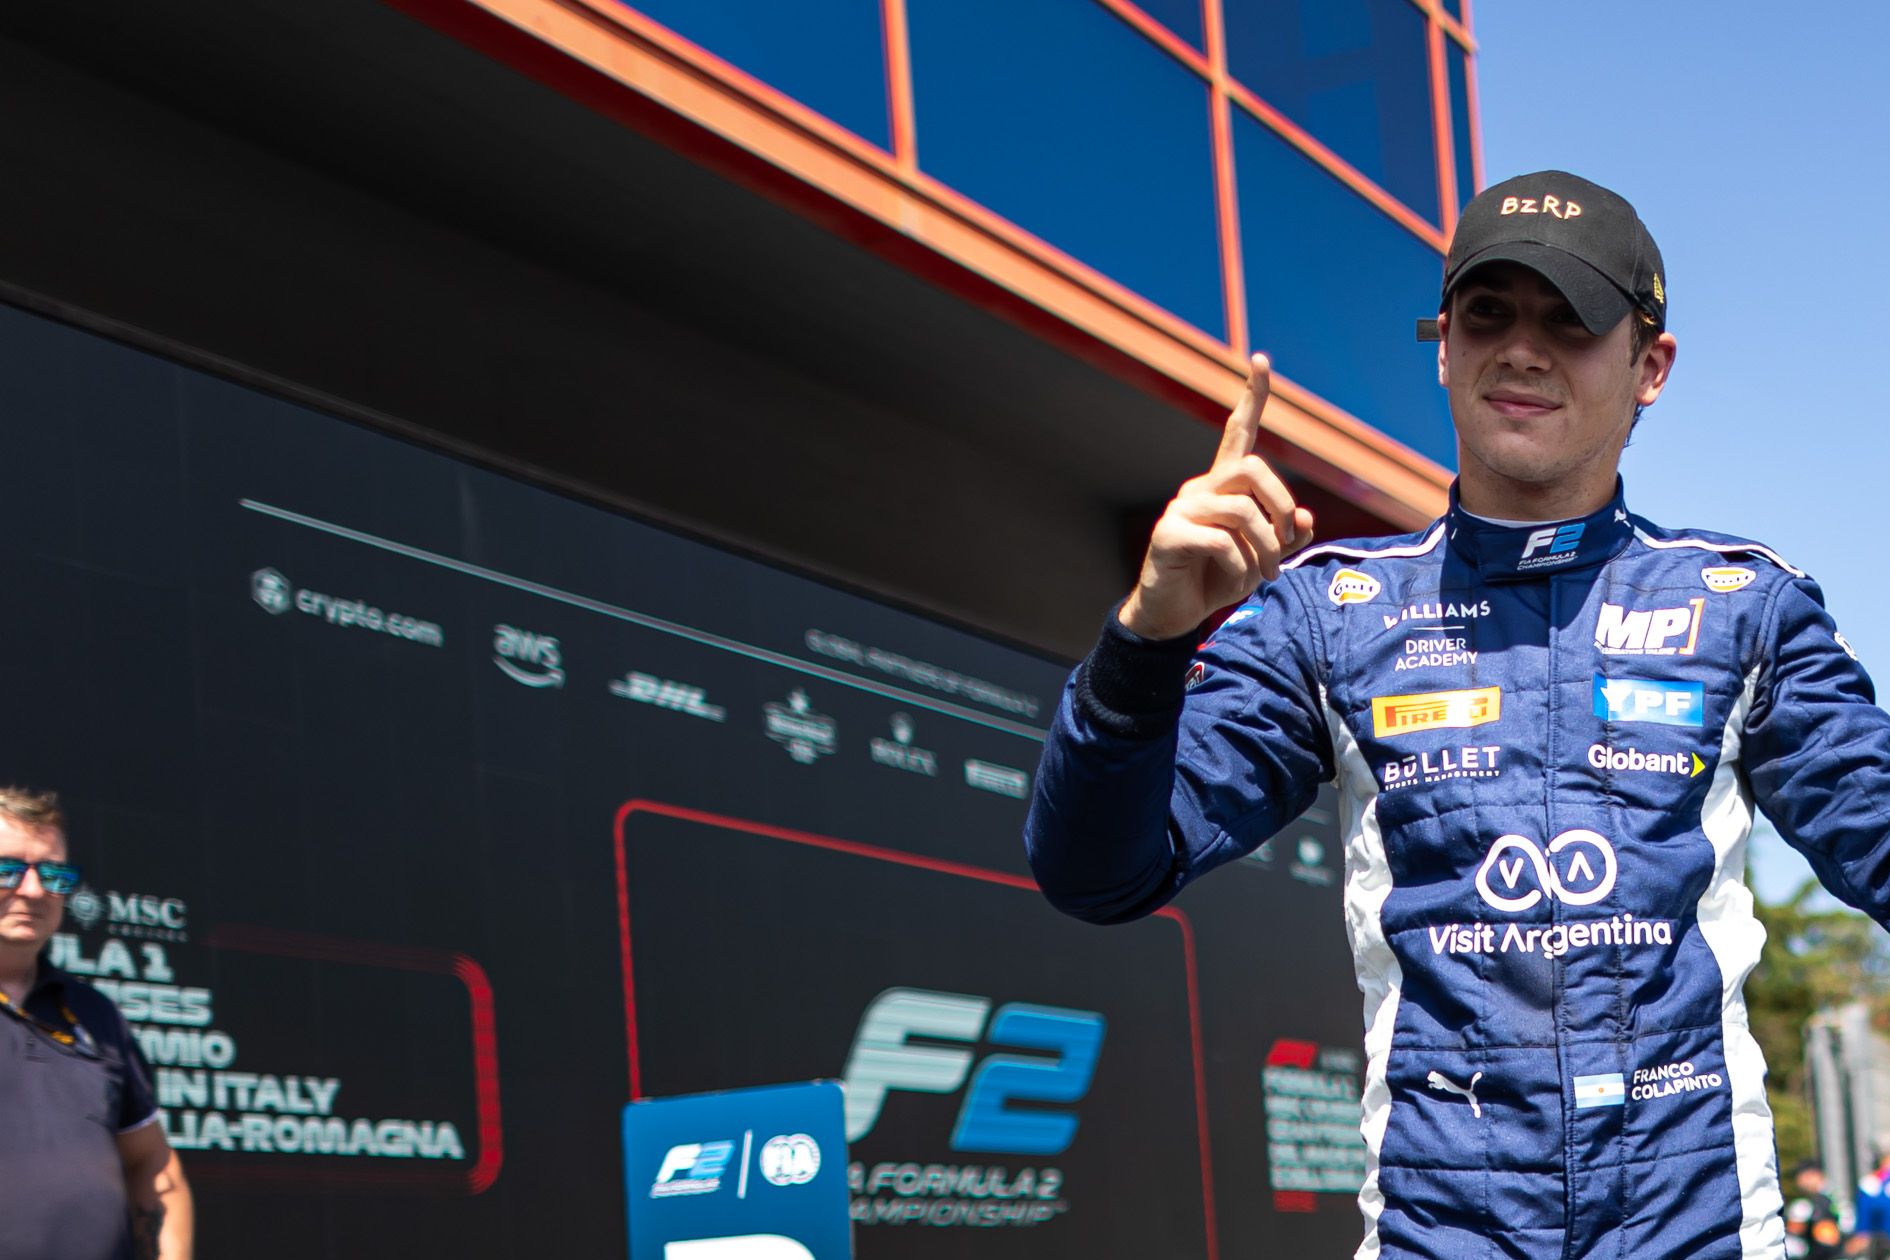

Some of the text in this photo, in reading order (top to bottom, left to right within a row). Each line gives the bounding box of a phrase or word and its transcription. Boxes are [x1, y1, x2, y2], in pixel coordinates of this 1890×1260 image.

[1500, 194, 1583, 220] BZRP
[1521, 522, 1586, 559] F2
[1394, 651, 1478, 672] ACADEMY
[1405, 637, 1467, 655] DRIVER
[1384, 697, 1489, 728] PIRELI
[1600, 686, 1692, 716] YPF
[1587, 744, 1690, 775] Globant
[106, 890, 187, 929] MSC
[1428, 913, 1673, 960] Visit Argentina
[845, 985, 1107, 1154] F2
[1633, 1061, 1695, 1084] FRANCO
[156, 1067, 340, 1116] IN ITALY
[1631, 1073, 1723, 1101] COLAPINTO
[866, 1161, 1036, 1199] FORMULA
